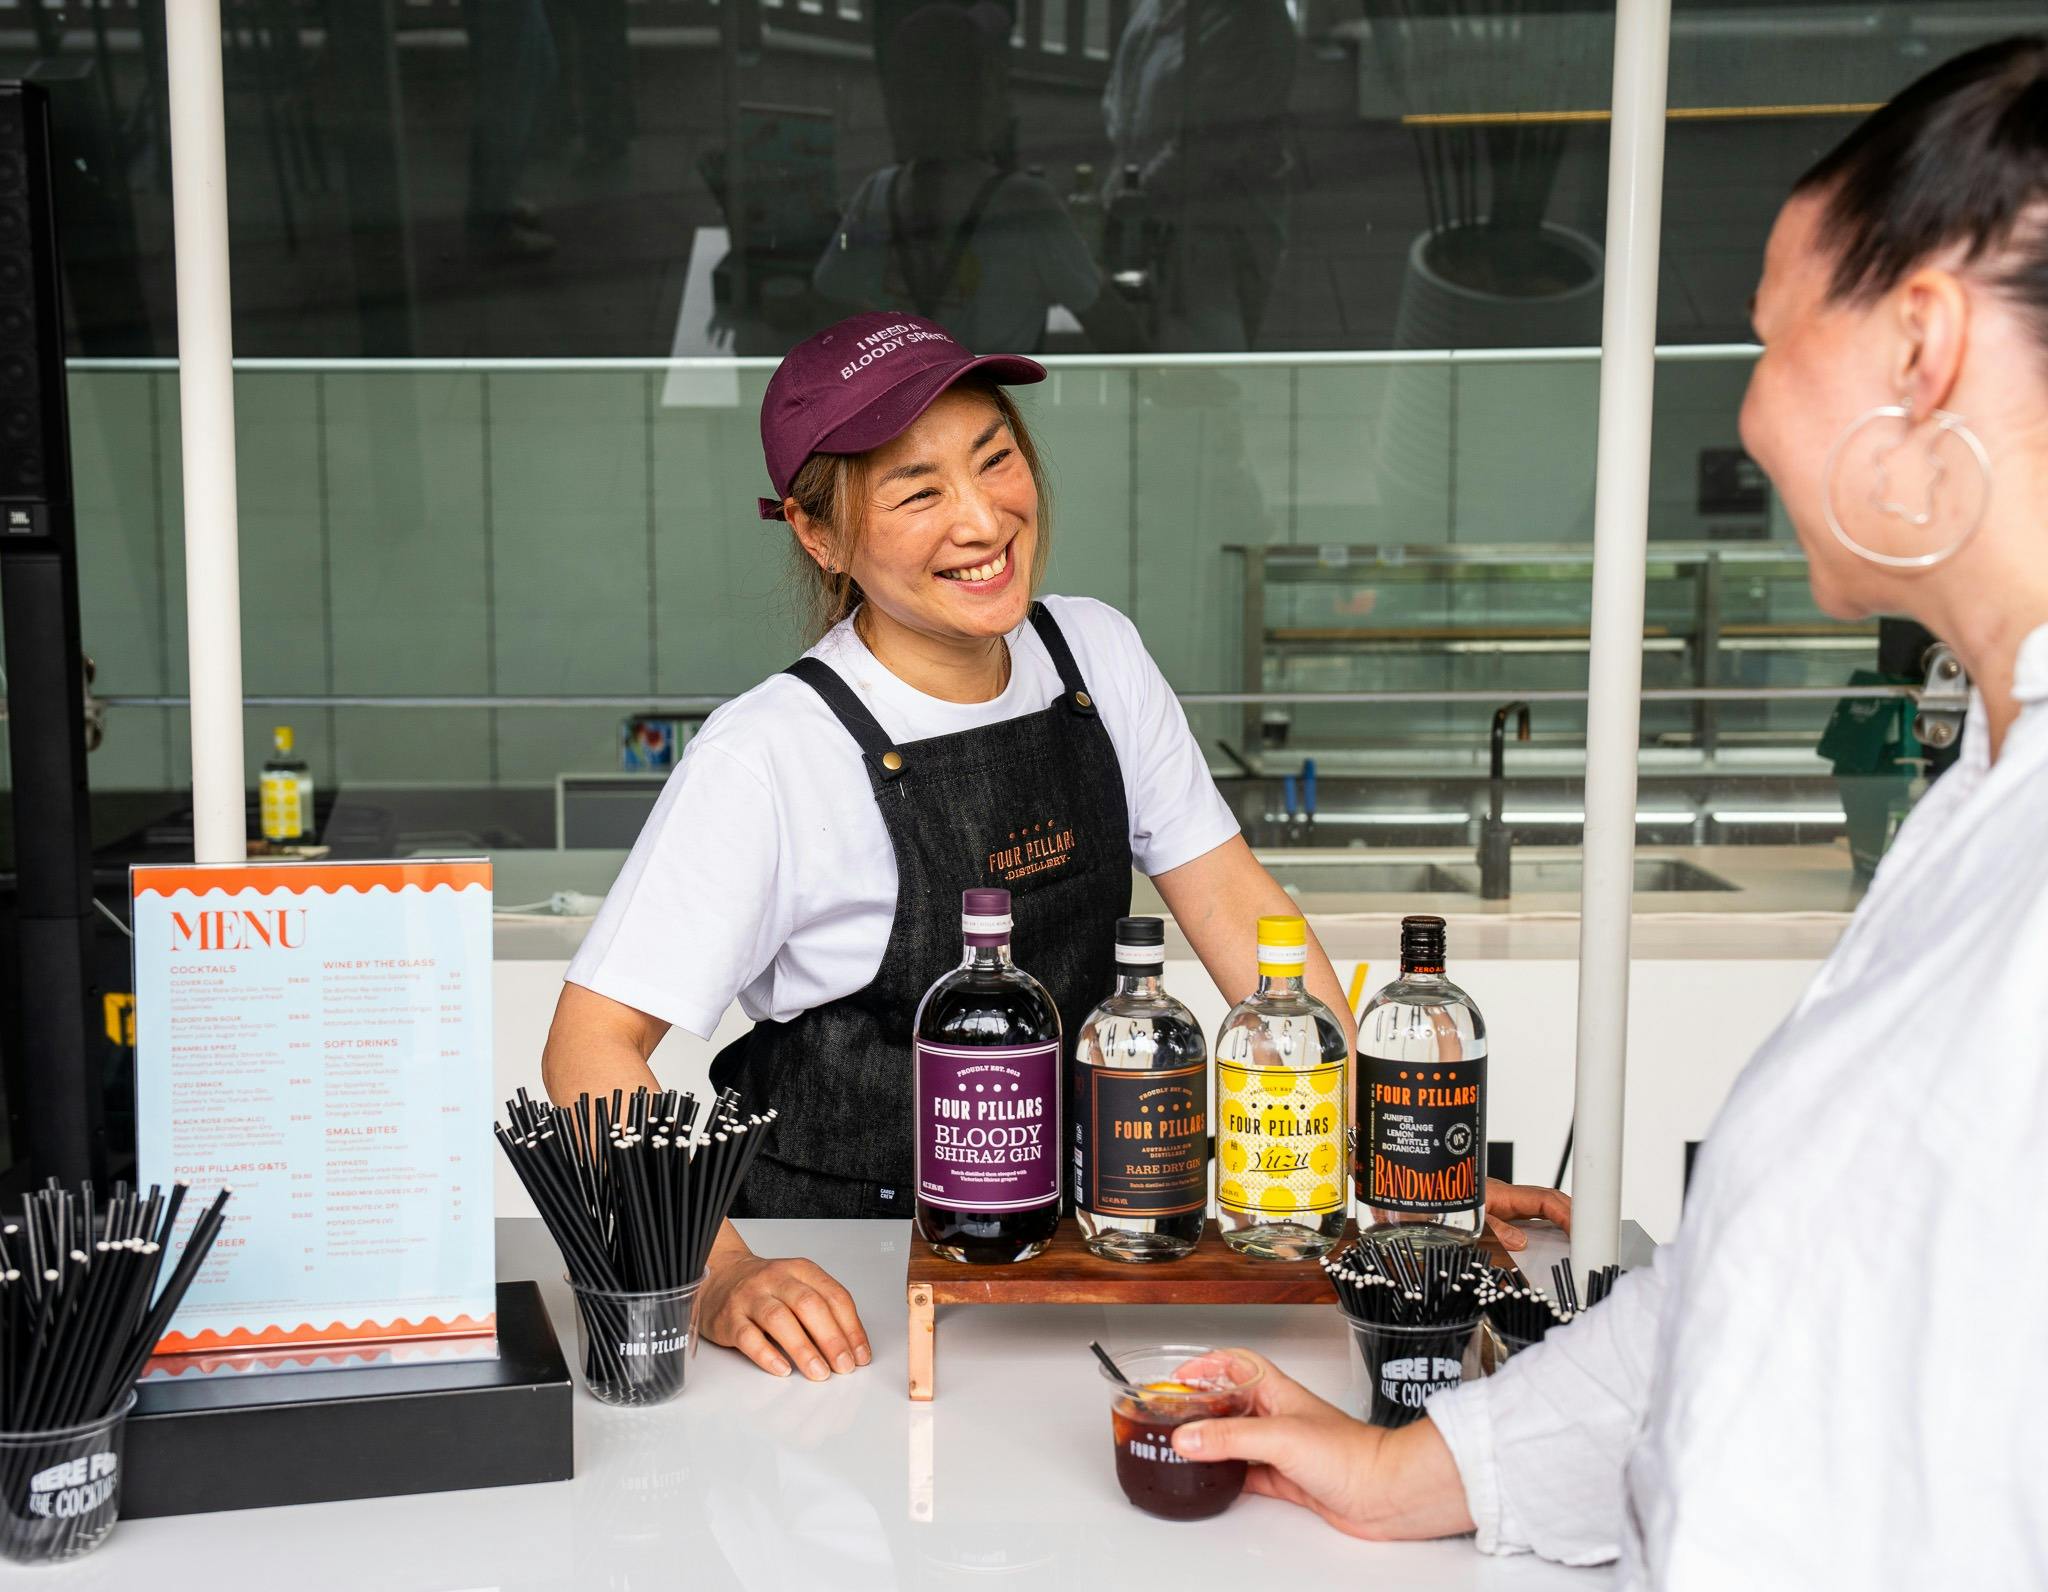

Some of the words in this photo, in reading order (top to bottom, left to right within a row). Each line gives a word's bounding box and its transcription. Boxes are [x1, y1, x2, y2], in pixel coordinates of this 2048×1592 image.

[856, 342, 867, 350] I
[864, 324, 910, 346] NEED
[909, 323, 922, 331] A
[840, 336, 905, 380] BLOODY
[988, 846, 1022, 873] FOUR
[1007, 854, 1067, 880] DISTILLERY
[169, 909, 308, 951] MENU
[170, 965, 237, 975] COCKTAILS
[323, 961, 353, 969] WINE
[356, 960, 371, 968] BY
[375, 960, 396, 968] THE
[398, 958, 436, 967] GLASS
[170, 979, 202, 987] CLOVER
[171, 1016, 202, 1024] BLOODY
[324, 1040, 353, 1048] SOFT
[356, 1038, 398, 1047] DRINKS
[957, 1065, 990, 1077] PROUDLY
[990, 1065, 1006, 1073] EST.
[1138, 1087, 1169, 1101] PROUDLY
[1375, 1083, 1411, 1107] FOUR
[1418, 1085, 1477, 1107] PILLARS
[934, 1097, 970, 1120] FOUR
[978, 1097, 1043, 1121] PILLARS
[1230, 1114, 1261, 1135] FOUR
[1269, 1117, 1329, 1137] PILLARS
[1382, 1113, 1414, 1123] JUNIPER
[325, 1127, 363, 1136] SMALL
[366, 1125, 398, 1135] BITES
[1114, 1120, 1153, 1140] FOUR
[1387, 1129, 1414, 1138] LEMON
[1399, 1122, 1434, 1132] ORANGE
[935, 1124, 1043, 1148] BLOODY
[1397, 1137, 1429, 1147] MYRTLE
[1433, 1139, 1440, 1147] &
[935, 1145, 1006, 1164] SHIRAZ
[1010, 1144, 1043, 1162] GIN
[1141, 1144, 1181, 1153] AUSTRALIAN
[1150, 1150, 1186, 1159] DISTILLERY
[1382, 1142, 1431, 1154] BOTANICALS
[174, 1166, 205, 1174] FOUR
[208, 1164, 255, 1173] PILLARS
[258, 1162, 288, 1171] G&TS
[1125, 1164, 1160, 1175] RARE
[1162, 1162, 1185, 1174] DRY
[1186, 1157, 1201, 1171] GIN
[1375, 1154, 1476, 1200] BANDWAGON
[880, 1188, 895, 1196] CARGO
[216, 1238, 246, 1247] BEER
[620, 1342, 647, 1356] FOUR
[651, 1333, 689, 1355] PILLARS
[1381, 1357, 1428, 1380] HERE
[1432, 1357, 1463, 1380] FOR
[1381, 1380, 1400, 1404] THE
[1130, 1440, 1157, 1461] FOUR
[31, 1456, 88, 1493] HERE
